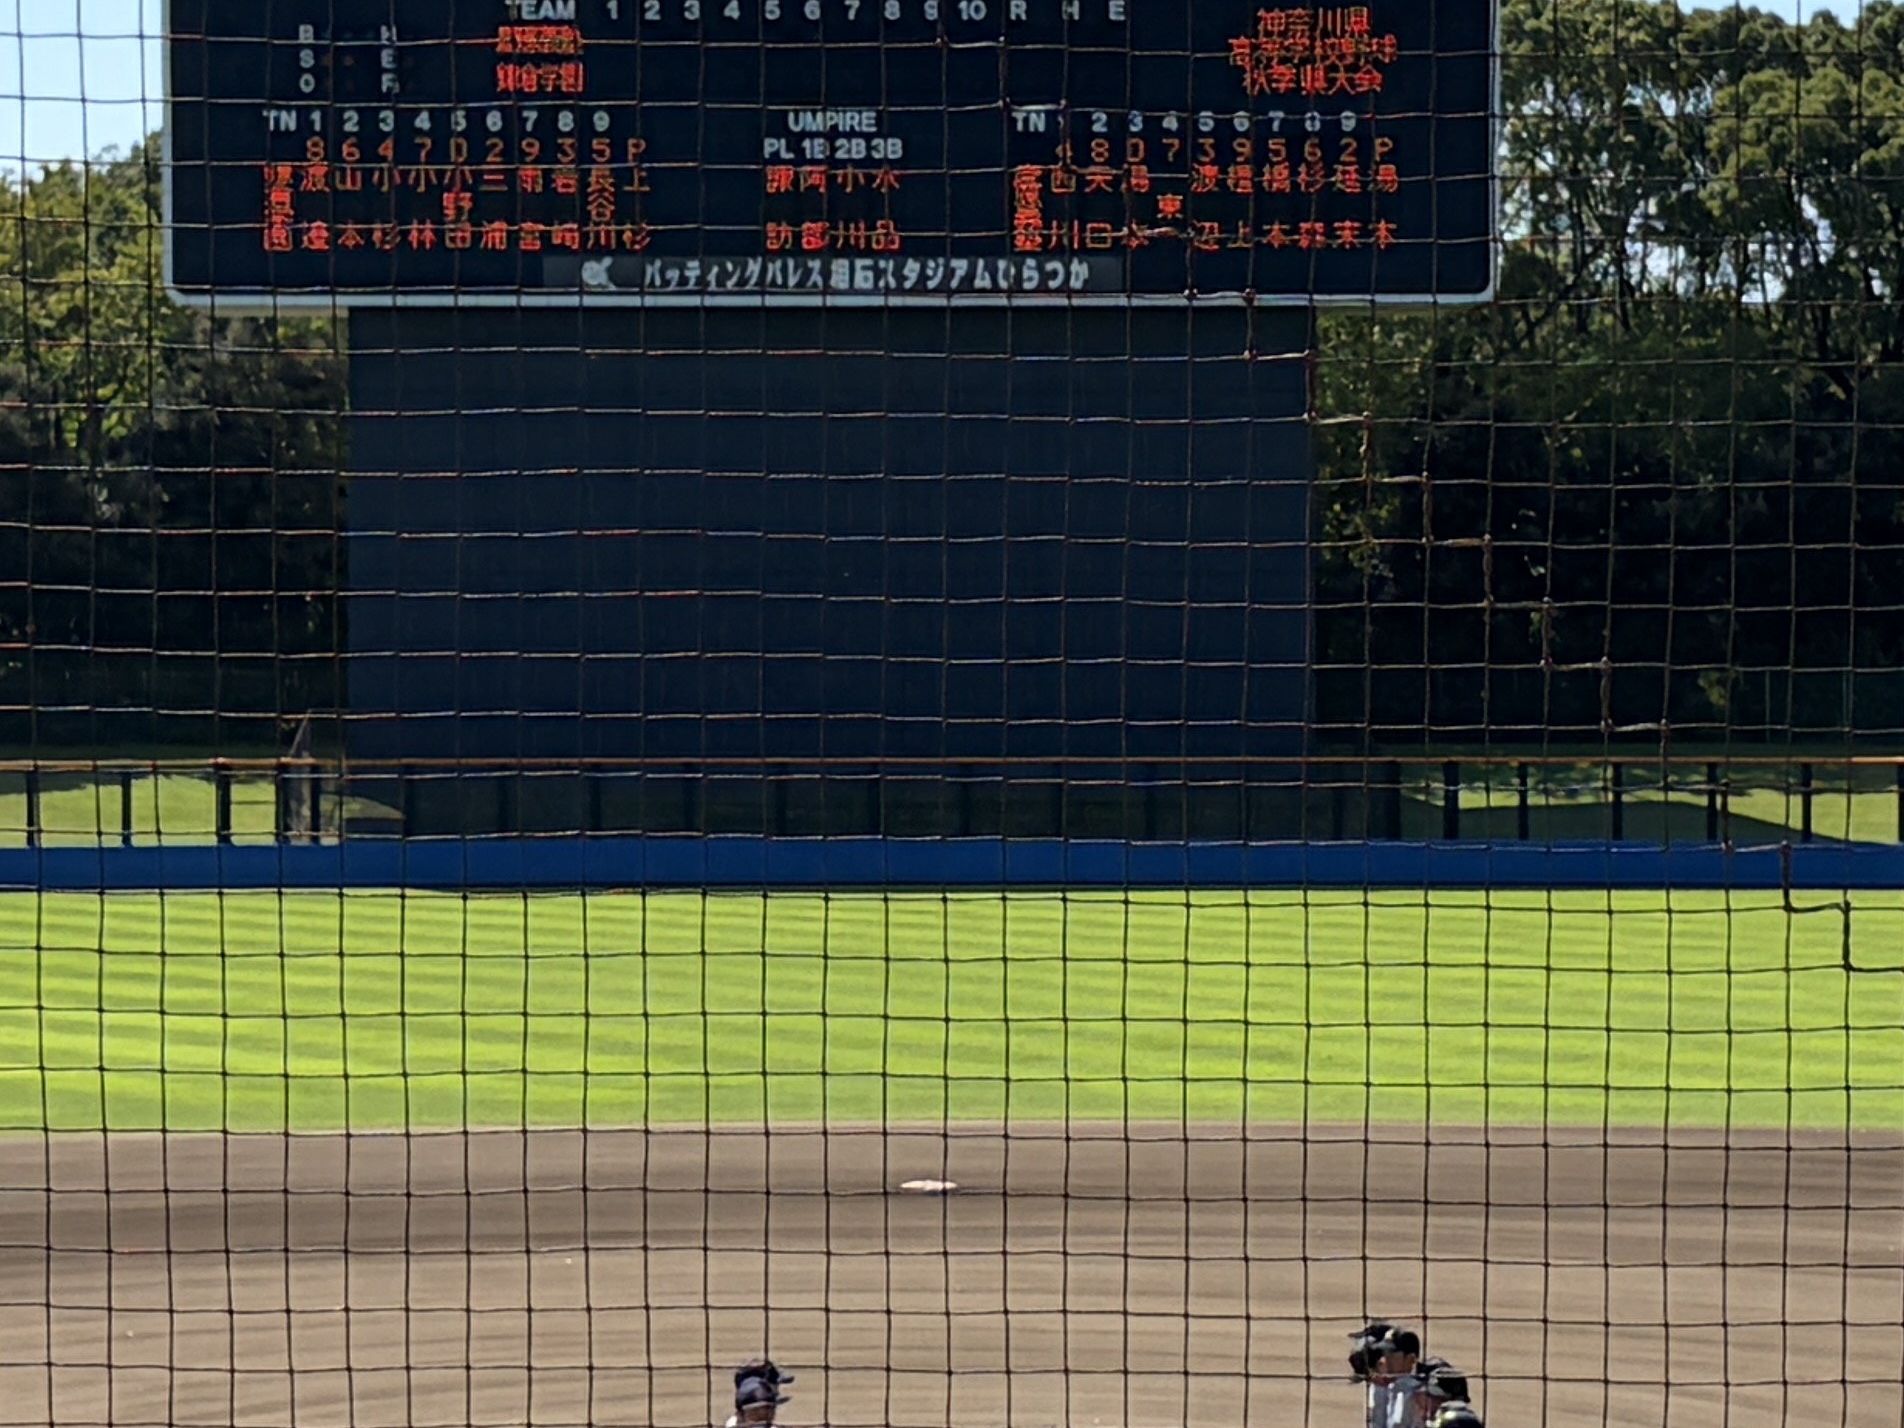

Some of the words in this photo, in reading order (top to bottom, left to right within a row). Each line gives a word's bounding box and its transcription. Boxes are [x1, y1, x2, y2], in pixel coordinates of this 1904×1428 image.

[1257, 7, 1372, 38] 神奈川県
[299, 48, 315, 69] S
[380, 48, 398, 69] E
[1228, 34, 1398, 68] 高等学校野球
[299, 72, 316, 94] O
[1242, 63, 1383, 96] 秋季県大会
[263, 111, 296, 132] TN
[309, 111, 322, 132] 1
[343, 111, 359, 132] 2
[378, 111, 394, 132] 3
[414, 111, 431, 132] 4
[451, 111, 467, 132] 5
[486, 111, 503, 132] 6
[522, 111, 538, 132] 7
[557, 111, 575, 132] 8
[593, 111, 610, 132] 9
[787, 111, 878, 132] UMPIRE
[1012, 112, 1046, 133] TN
[1091, 111, 1108, 132] 2
[1128, 111, 1144, 132] 3
[1162, 111, 1179, 132] 4
[1197, 111, 1215, 132] 5
[1233, 111, 1250, 132] 6
[1267, 111, 1285, 132] 7
[1340, 111, 1357, 132] 9
[306, 136, 326, 162] 8
[341, 136, 361, 162] 6
[413, 136, 432, 162] 7
[485, 136, 504, 162] 2
[521, 136, 541, 162] 9
[557, 136, 576, 162] 3
[592, 136, 611, 162] 5
[627, 136, 646, 162] P
[763, 138, 795, 160] PL
[801, 138, 830, 160] 1B
[834, 138, 866, 160] 2B
[871, 138, 903, 160] 3B
[1090, 137, 1110, 163] 8
[1161, 137, 1181, 163] 7
[1197, 137, 1215, 163] 3
[1232, 137, 1251, 163] 9
[1268, 137, 1287, 163] 5
[1303, 137, 1322, 163] 6
[1339, 137, 1358, 163] 2
[1374, 137, 1394, 163] P
[407, 164, 438, 250] 小林
